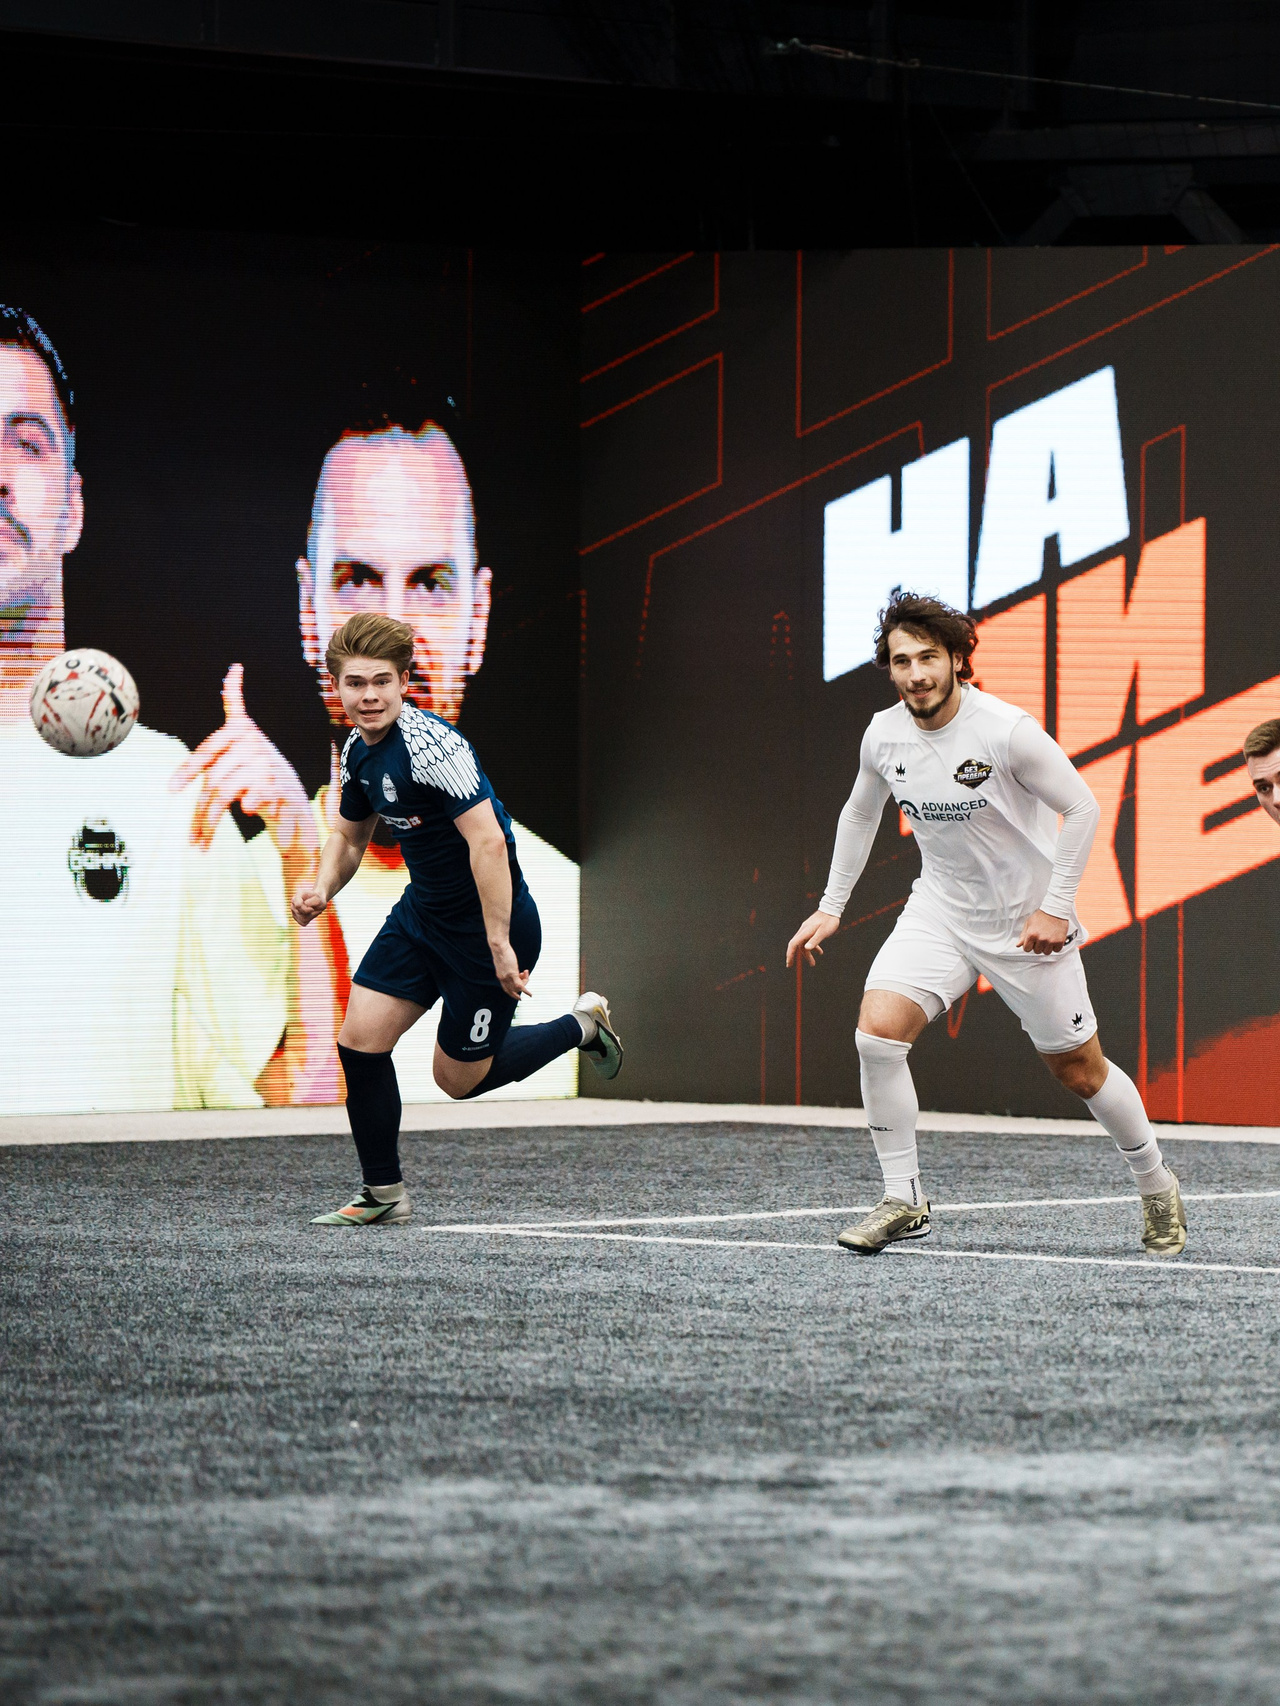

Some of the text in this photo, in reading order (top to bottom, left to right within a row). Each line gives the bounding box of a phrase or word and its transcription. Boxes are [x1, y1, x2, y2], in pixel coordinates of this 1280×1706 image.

[823, 365, 1130, 683] НА
[964, 766, 978, 774] БЕЗ
[957, 772, 988, 781] ПРЕДЕЛА
[921, 799, 988, 811] ADVANCED
[923, 812, 971, 821] ENERGY
[470, 1008, 492, 1043] 8
